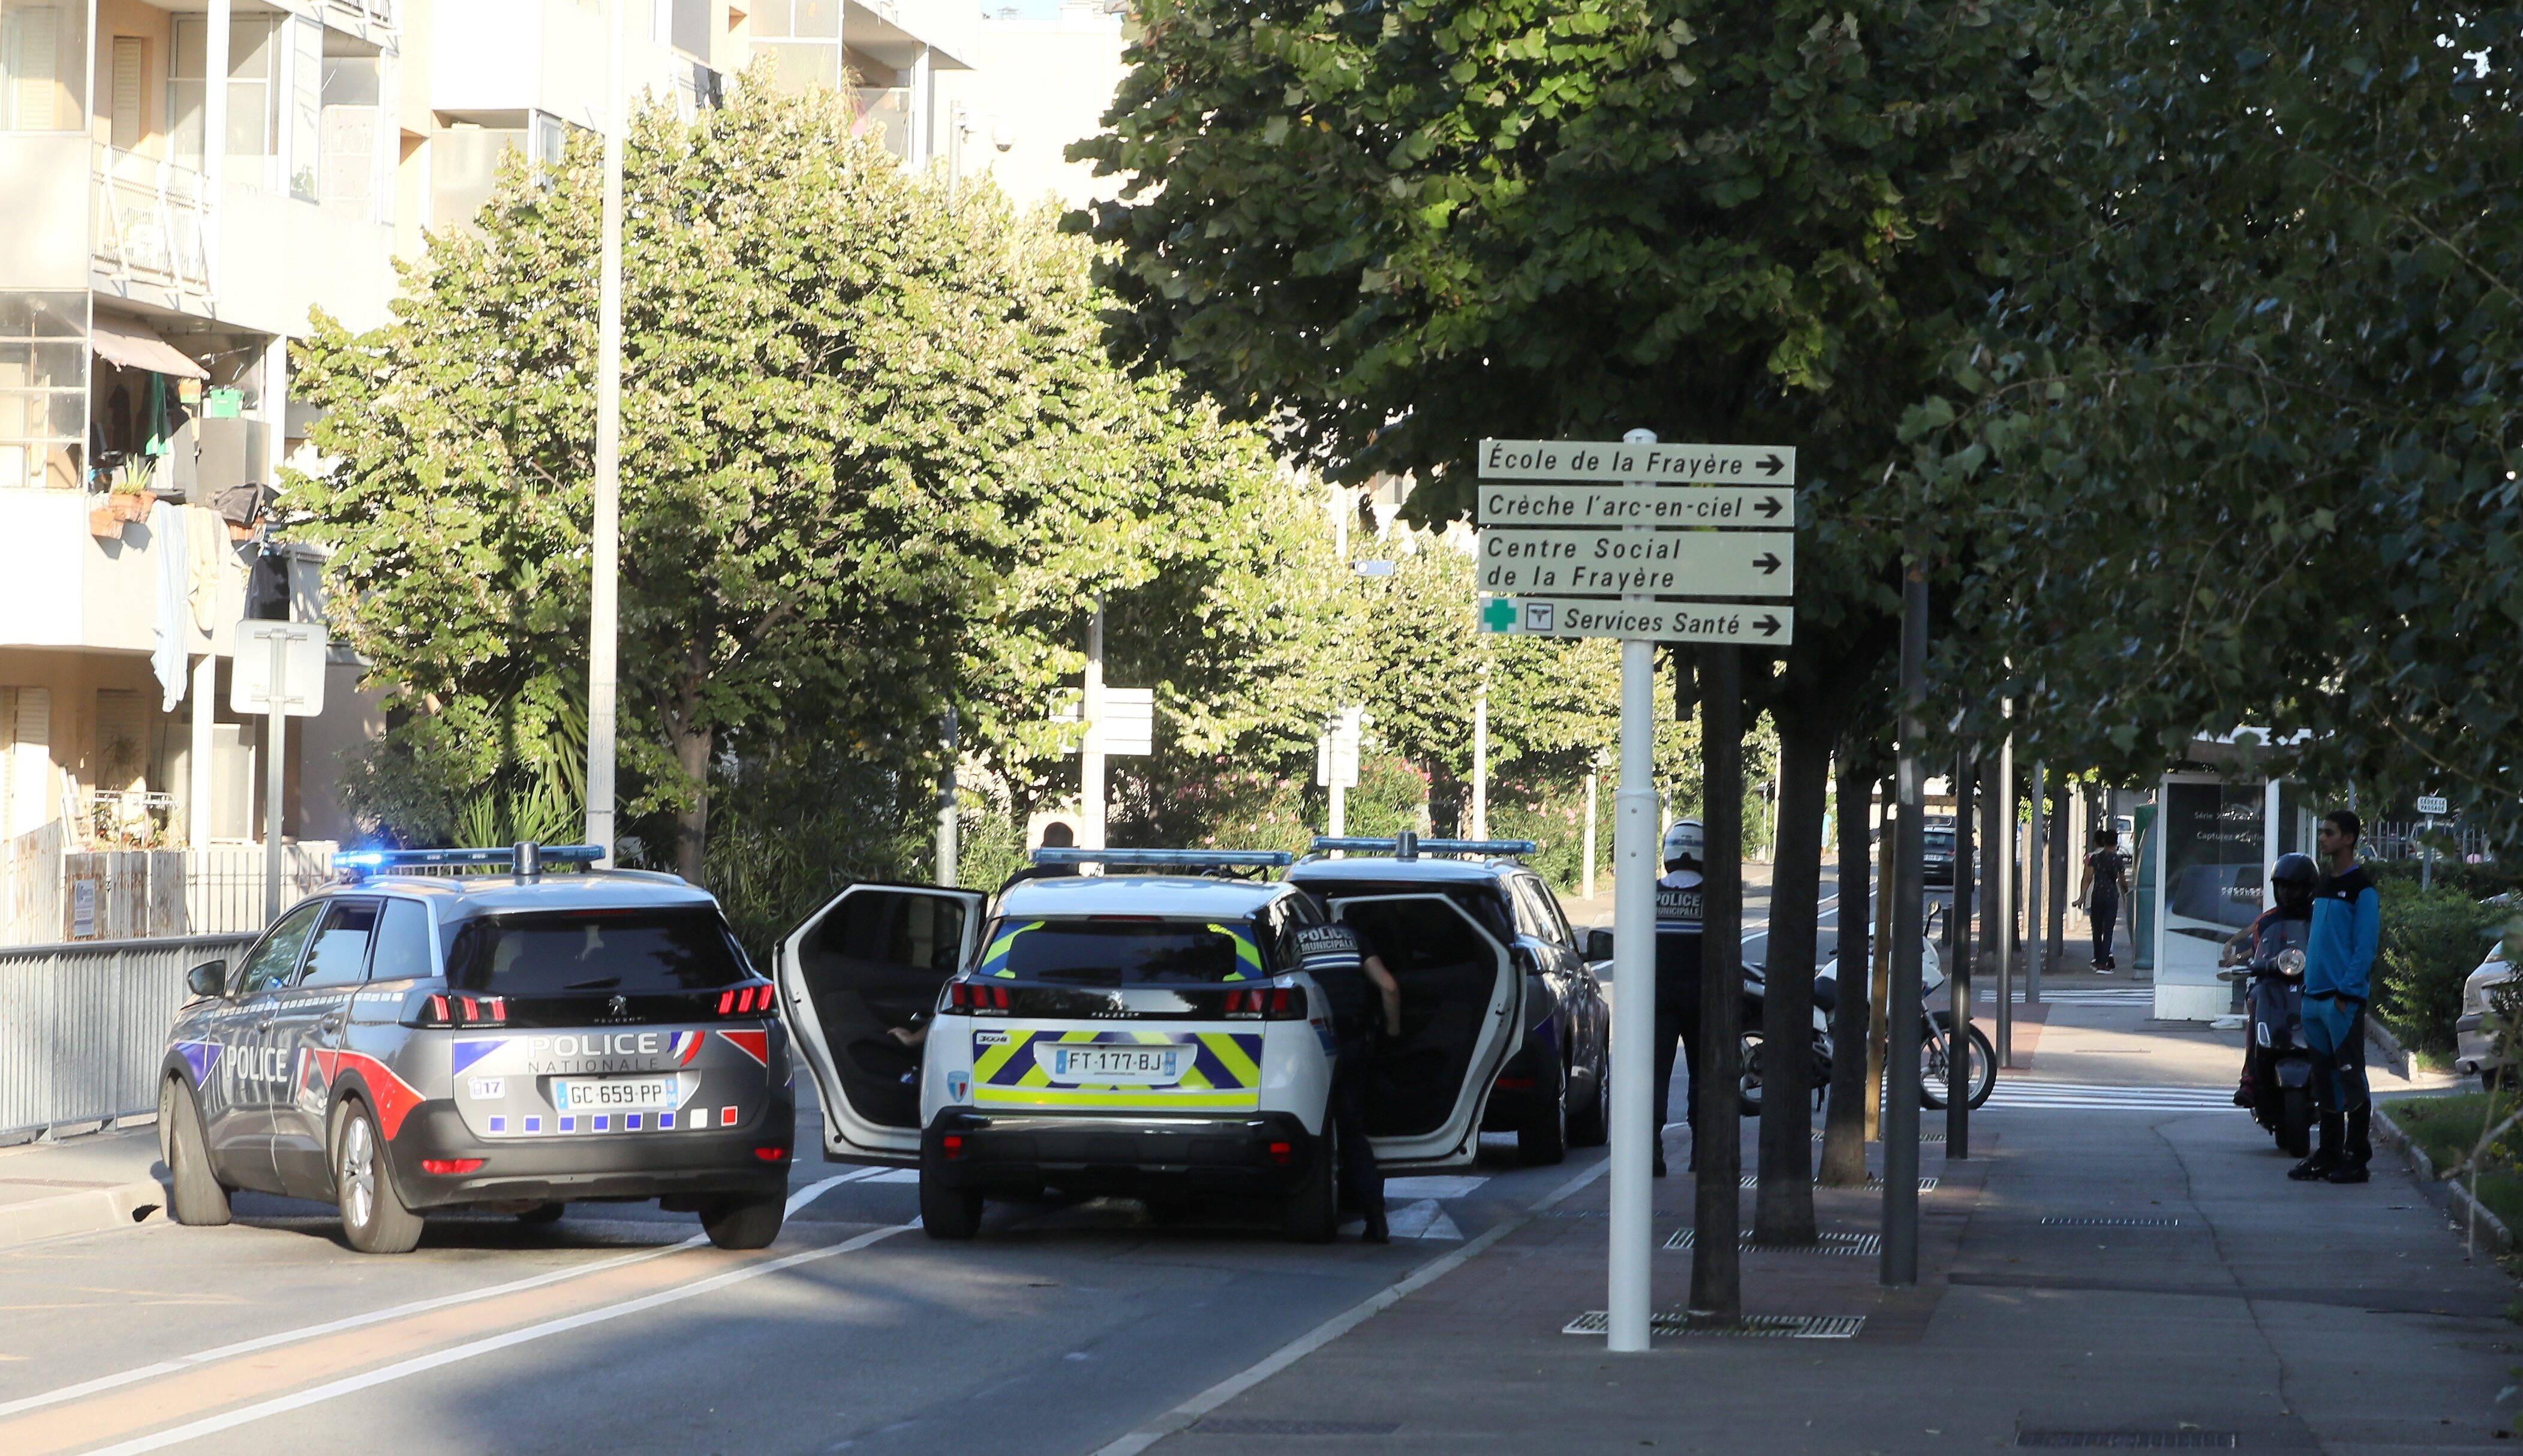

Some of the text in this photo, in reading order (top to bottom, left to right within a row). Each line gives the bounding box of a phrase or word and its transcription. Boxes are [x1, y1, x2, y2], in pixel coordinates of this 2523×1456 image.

[1488, 444, 1743, 479] École de la Frayère
[1488, 494, 1575, 515] Crèche
[1487, 537, 1681, 560] Centre Social
[1487, 566, 1675, 592] de la Frayère
[1564, 609, 1740, 635] Services Santé
[528, 1032, 658, 1059] POLICE
[226, 1045, 287, 1082] POLICE
[528, 1057, 658, 1073] NATIONALE
[483, 1082, 500, 1094] 17
